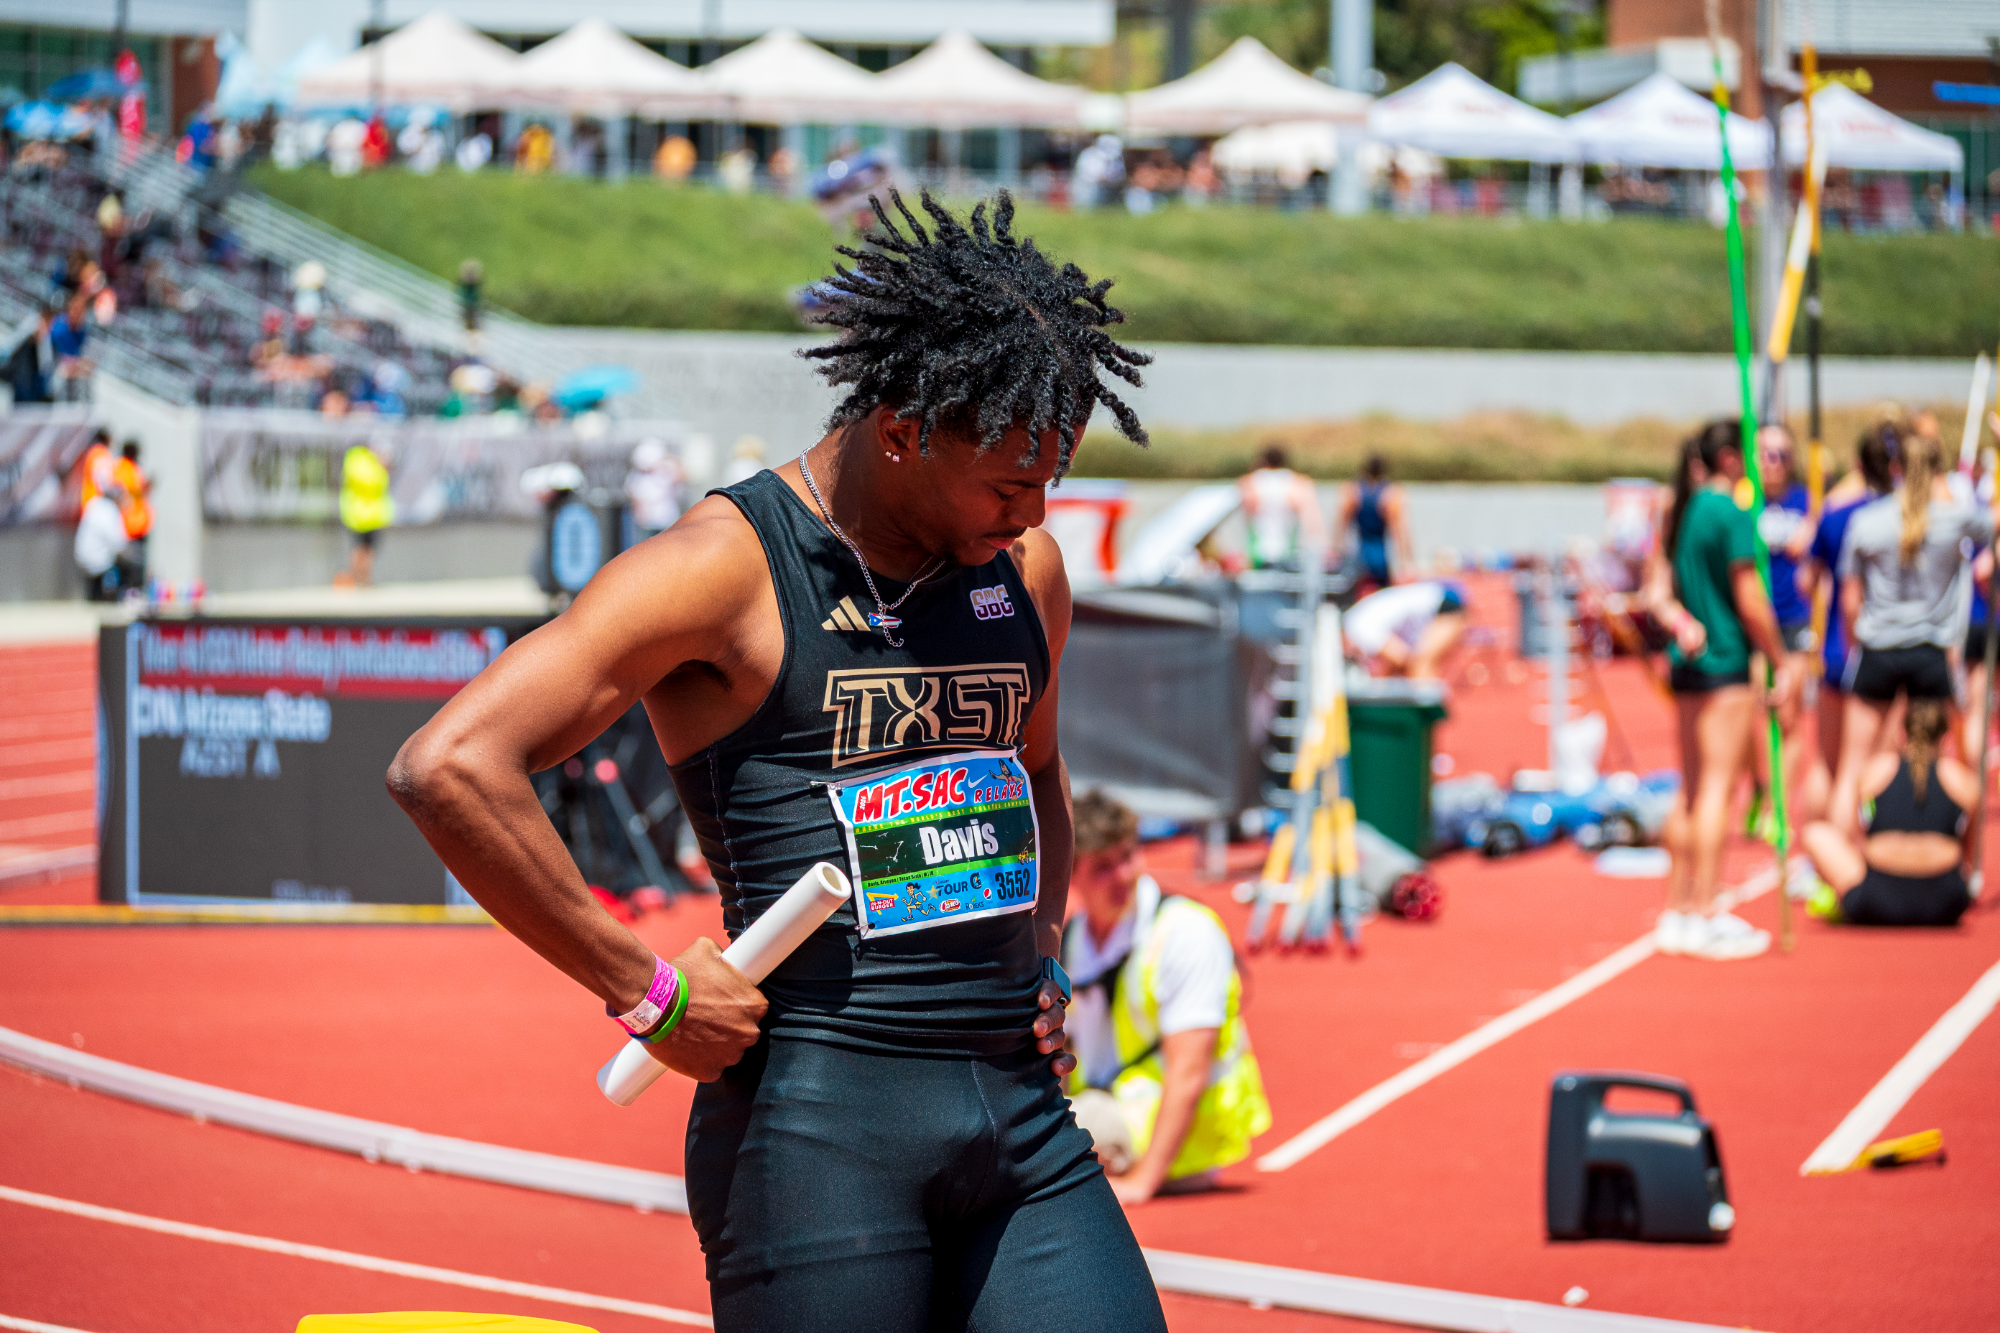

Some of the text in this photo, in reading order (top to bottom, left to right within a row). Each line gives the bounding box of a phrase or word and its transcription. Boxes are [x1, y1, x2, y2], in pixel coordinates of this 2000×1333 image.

[970, 584, 1015, 621] SBC
[181, 687, 262, 736] Arizona
[263, 688, 331, 741] State
[834, 670, 1028, 758] TXST
[854, 768, 967, 823] MT.SAC
[974, 782, 1023, 802] RELAYS
[910, 812, 943, 823] WORLD'S
[947, 808, 965, 817] BEST
[969, 802, 1001, 813] ATHLETES
[1003, 799, 1030, 808] COMPETE
[918, 818, 999, 866] Davis
[936, 881, 968, 897] TOUR
[994, 868, 1031, 900] 3552
